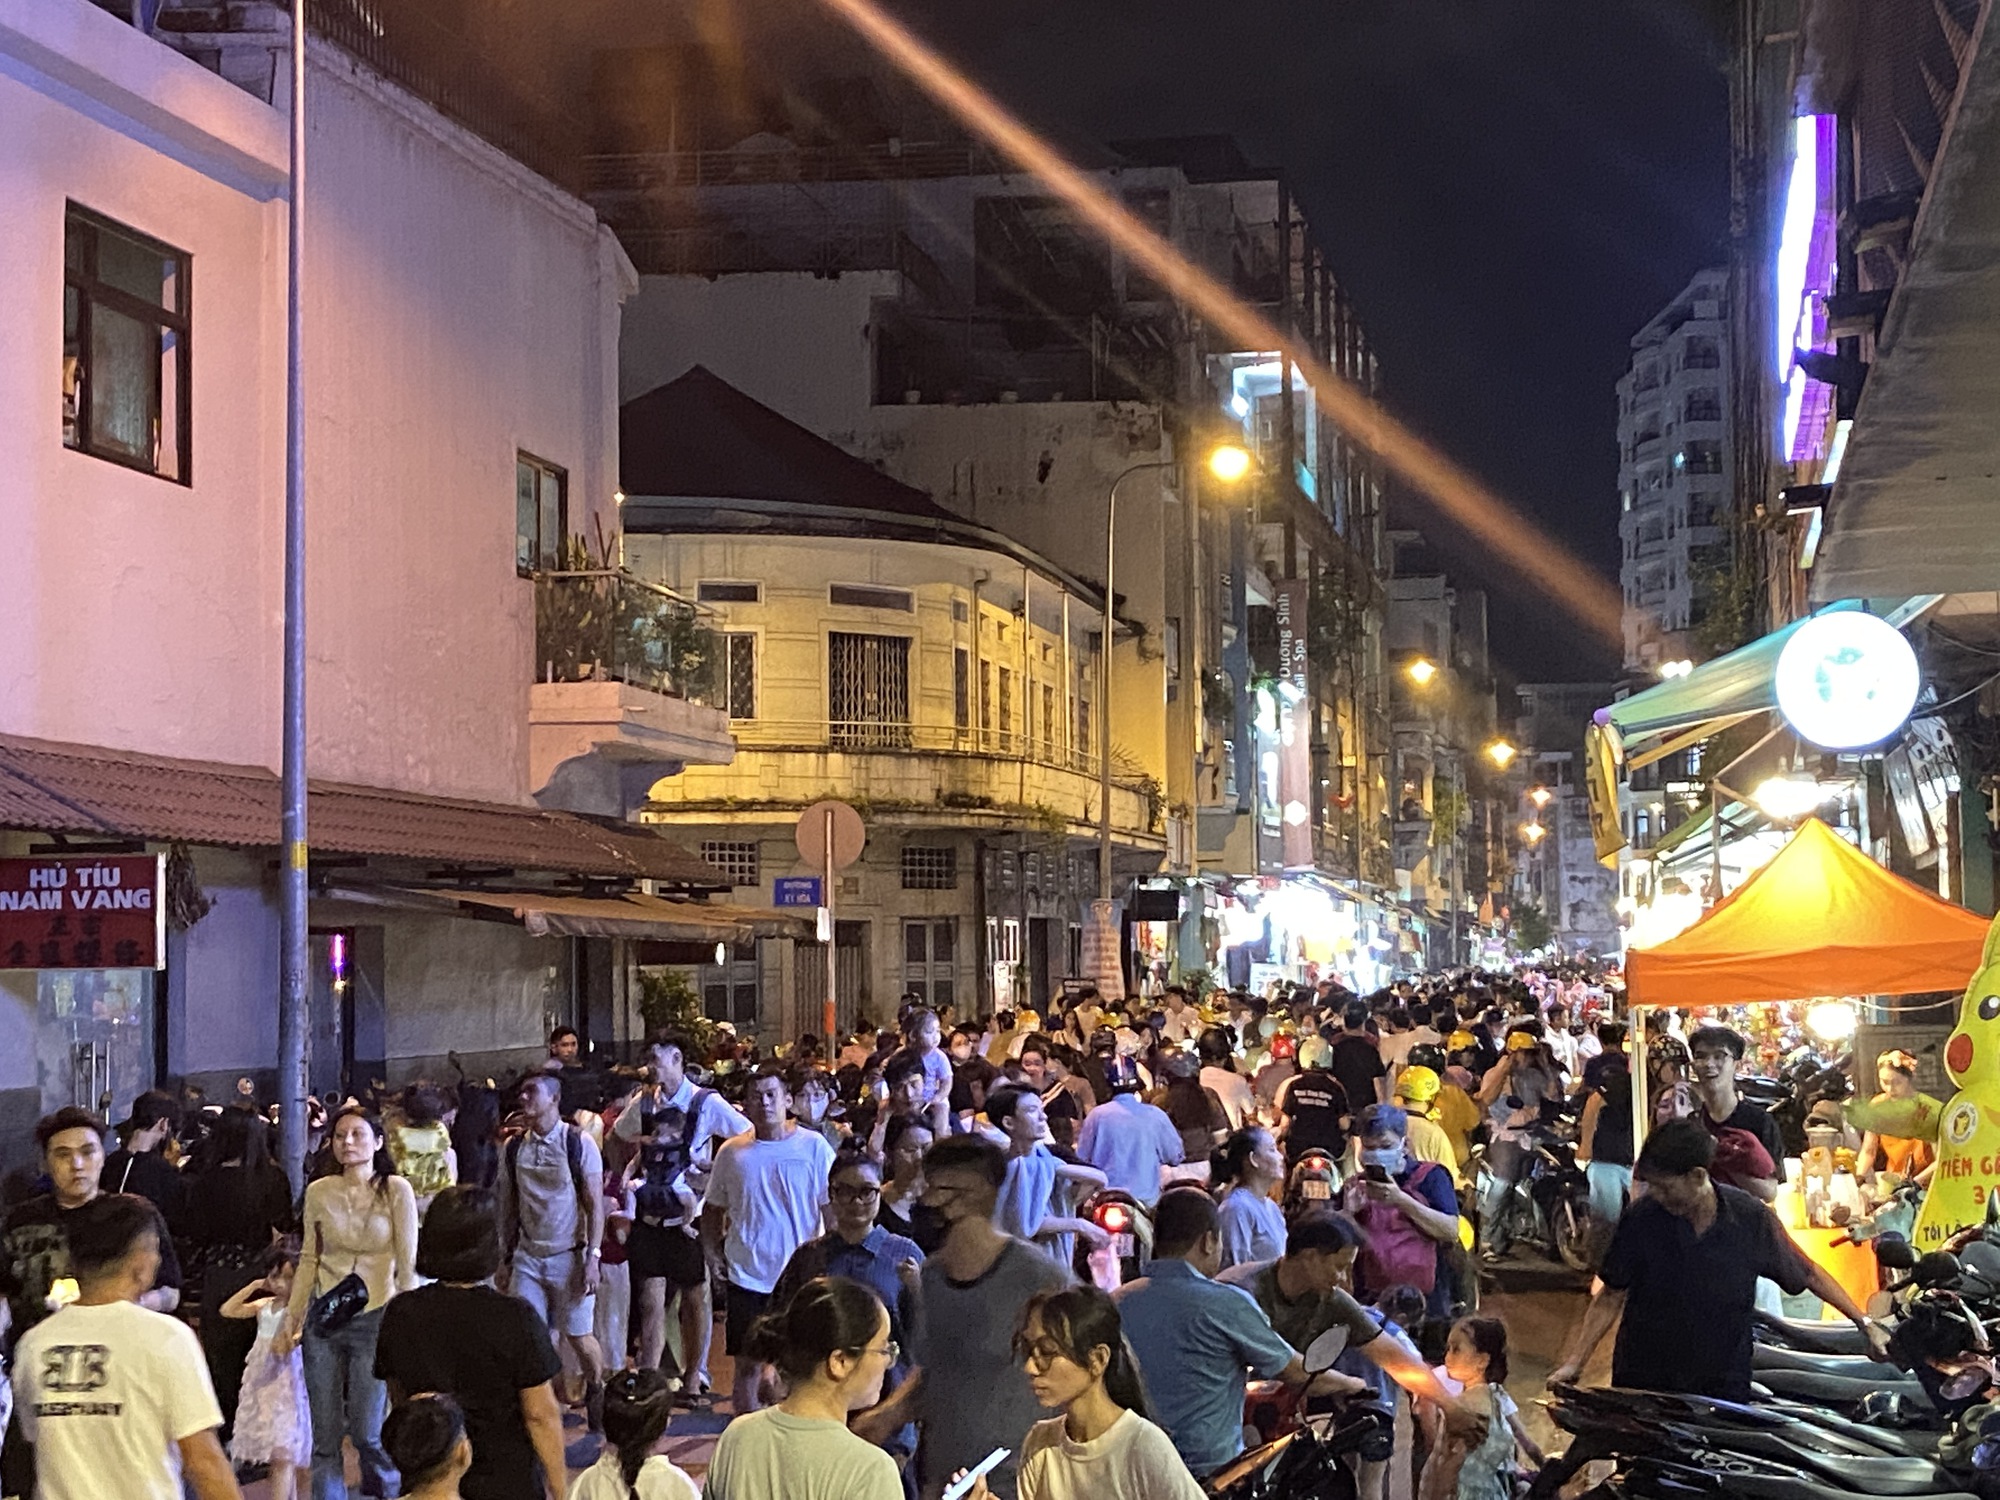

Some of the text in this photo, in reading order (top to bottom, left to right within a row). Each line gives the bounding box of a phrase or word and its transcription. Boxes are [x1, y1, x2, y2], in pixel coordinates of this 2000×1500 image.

[1276, 593, 1290, 625] Sinh
[1293, 639, 1306, 661] Spa
[29, 861, 121, 888] HỦ TÍU
[0, 888, 150, 911] NAM VANG
[1940, 1152, 1973, 1183] TIỆM
[1973, 1185, 1986, 1205] 3
